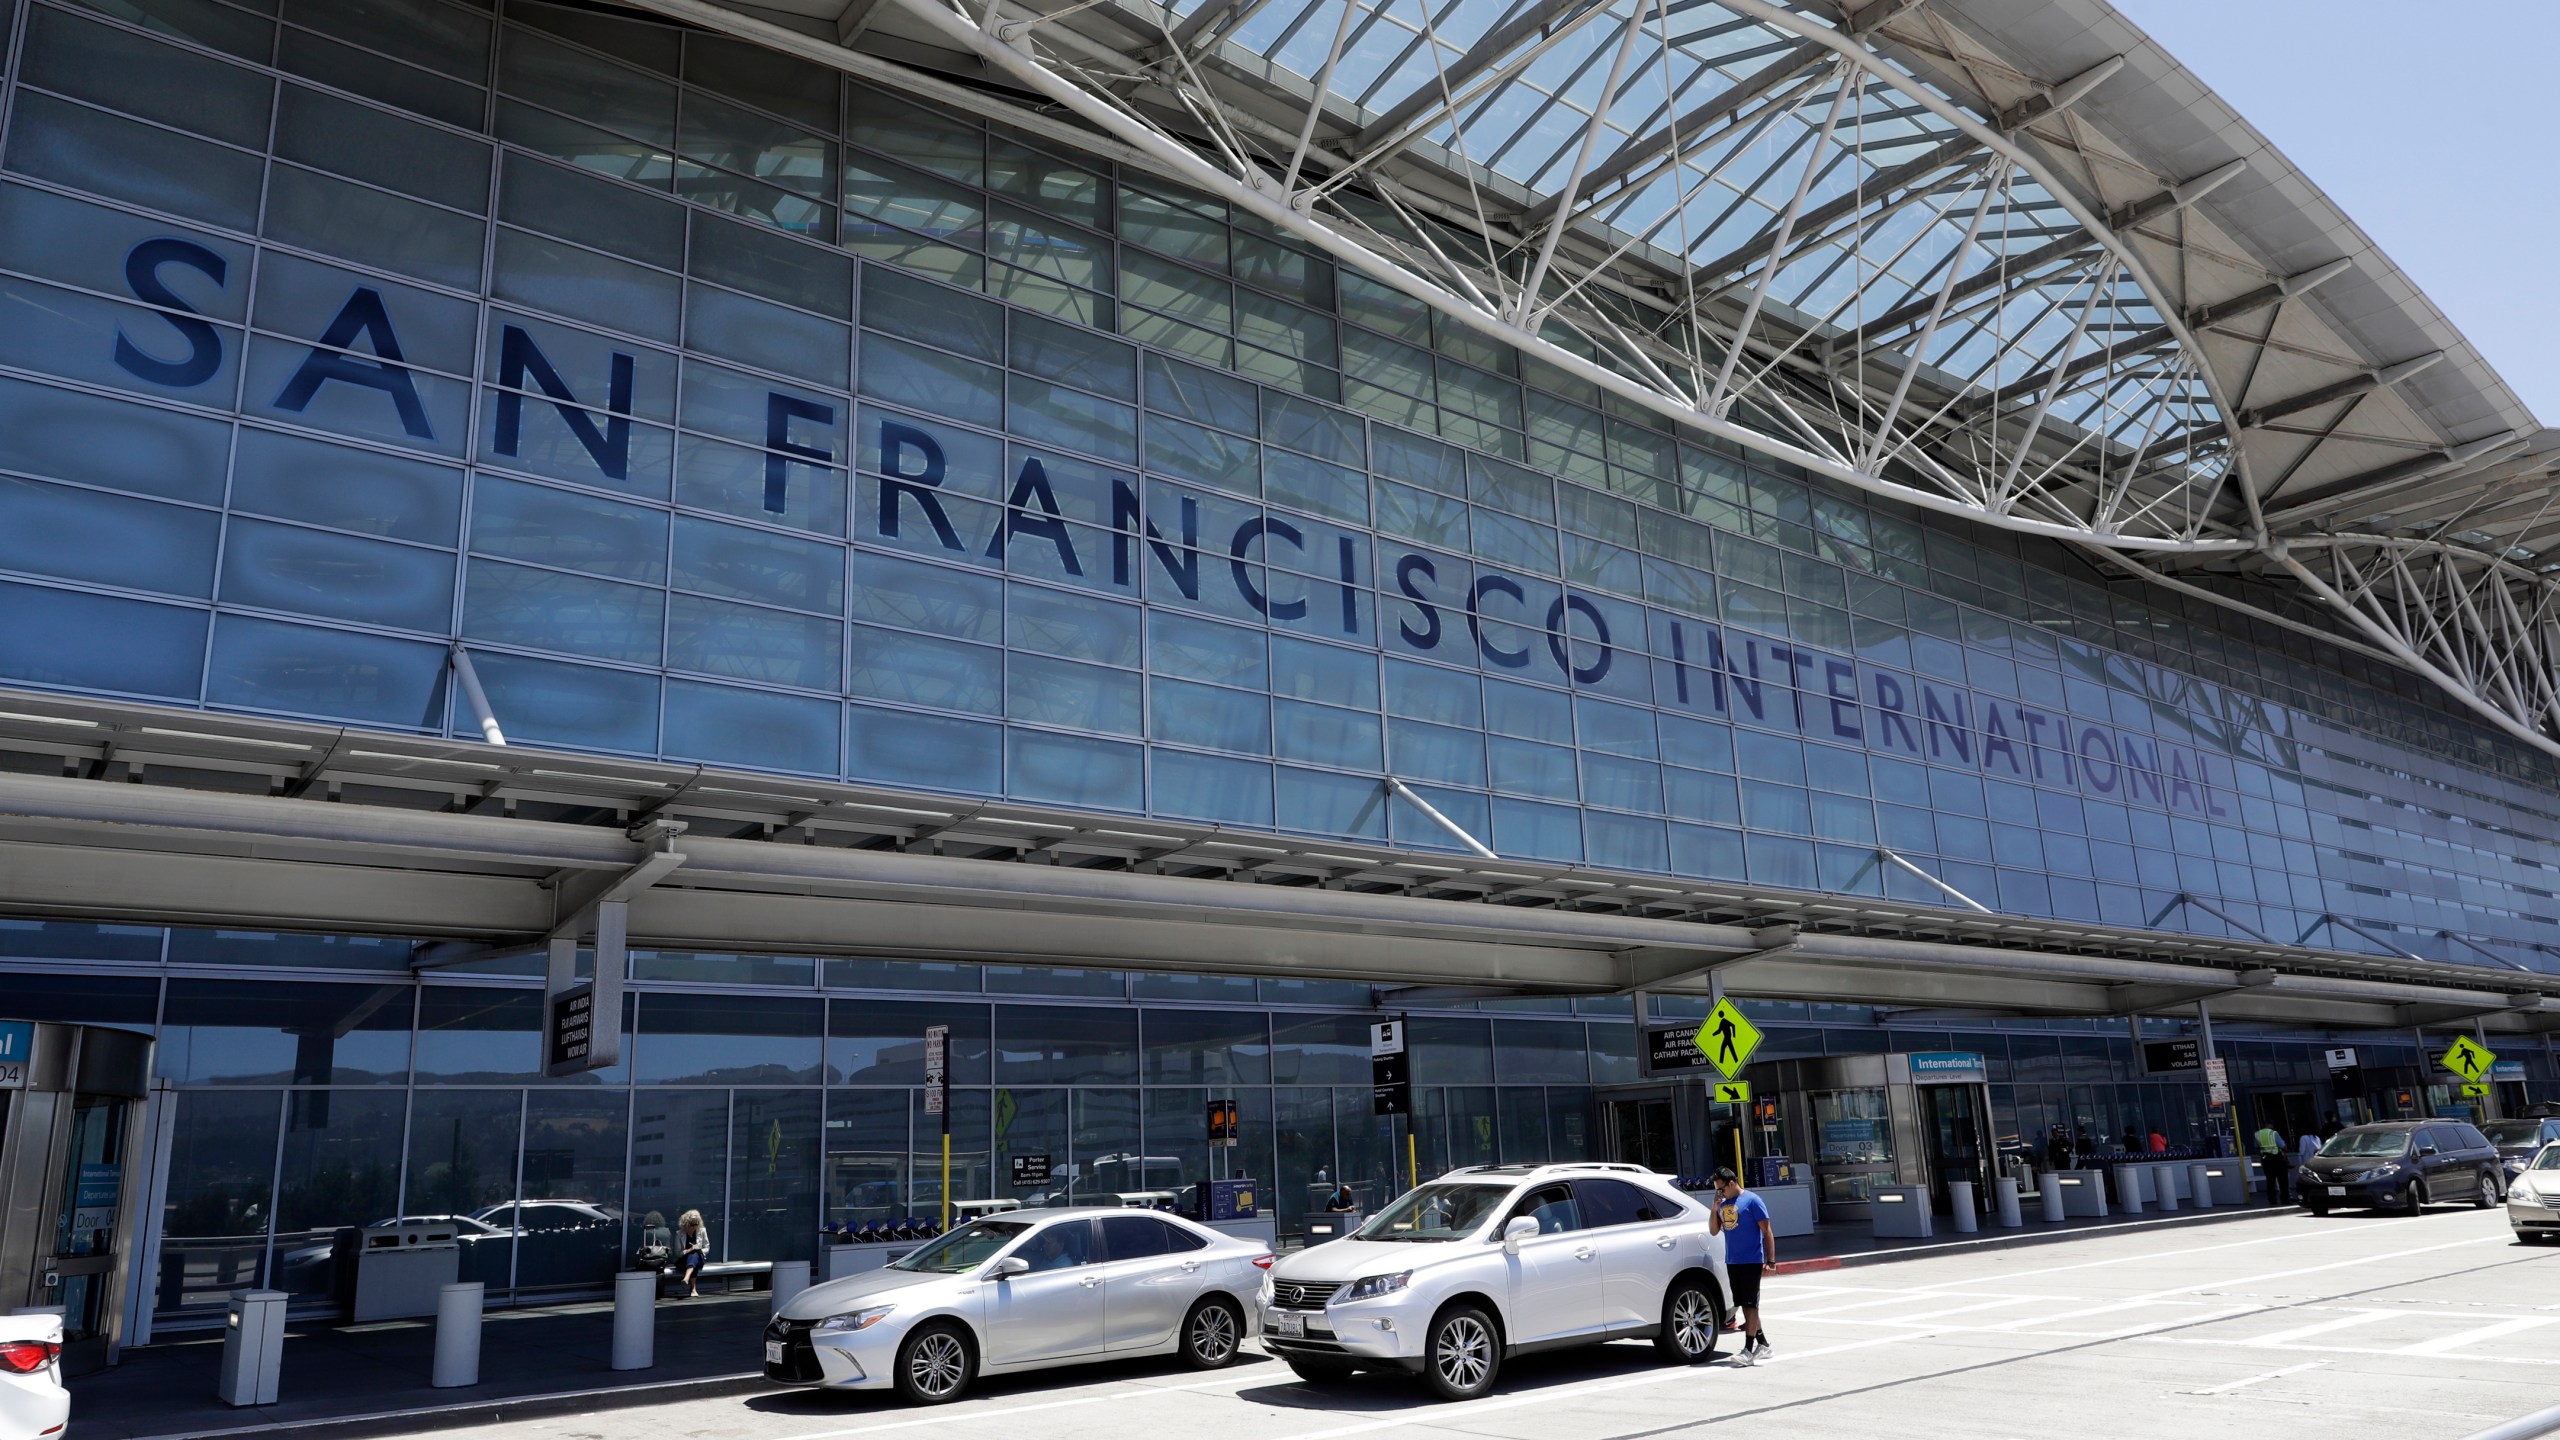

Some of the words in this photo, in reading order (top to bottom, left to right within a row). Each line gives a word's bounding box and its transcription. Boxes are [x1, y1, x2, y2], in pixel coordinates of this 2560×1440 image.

[113, 236, 636, 481] SAN
[764, 391, 1613, 684] FRANCISCO
[1671, 620, 2227, 818] INTERNATIONAL
[569, 1000, 577, 1012] AIR
[577, 996, 590, 1010] INDIA
[569, 1011, 589, 1027] AIRWAYS
[562, 1027, 588, 1045] LUFTHANSA
[1664, 1031, 1675, 1039] AIR
[1675, 1029, 1699, 1038] CANAD
[1665, 1040, 1676, 1049] AIR
[1677, 1039, 1694, 1047] FRAN
[567, 1046, 579, 1058] WOW
[579, 1043, 587, 1055] AIR
[1653, 1050, 1679, 1059] CATHAY
[1691, 1057, 1707, 1066] KLM
[1918, 1057, 1972, 1069] International
[2171, 1060, 2198, 1068] VOLARIS
[1828, 1143, 1849, 1152] Door
[1858, 1141, 1873, 1151] 03
[76, 1213, 100, 1228] Door
